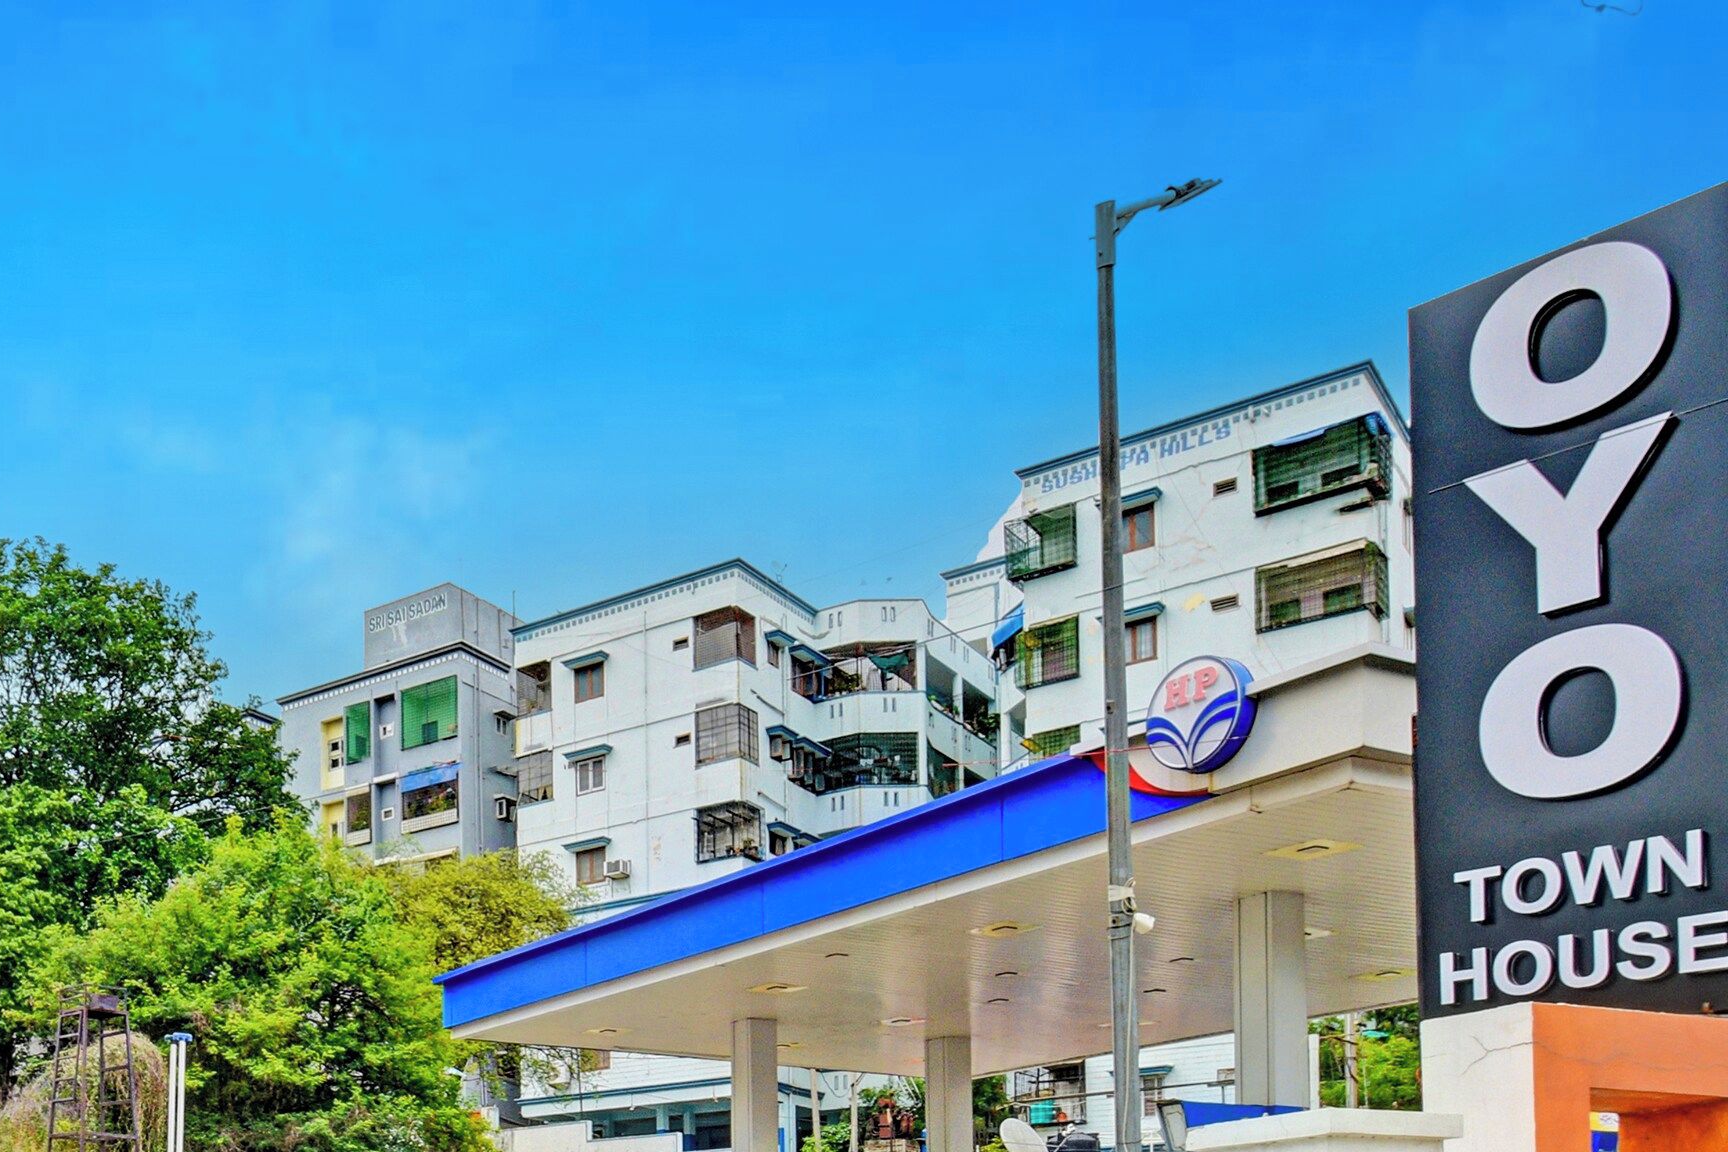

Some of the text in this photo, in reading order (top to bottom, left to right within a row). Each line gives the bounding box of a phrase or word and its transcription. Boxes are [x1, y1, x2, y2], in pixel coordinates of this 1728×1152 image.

[1159, 425, 1231, 459] HILLS
[1463, 240, 1682, 799] OYO
[369, 593, 447, 633] SRI SAI SADAN
[1164, 666, 1218, 712] HP
[1453, 828, 1706, 922] TOWN
[1439, 910, 1728, 1006] HOUSE
